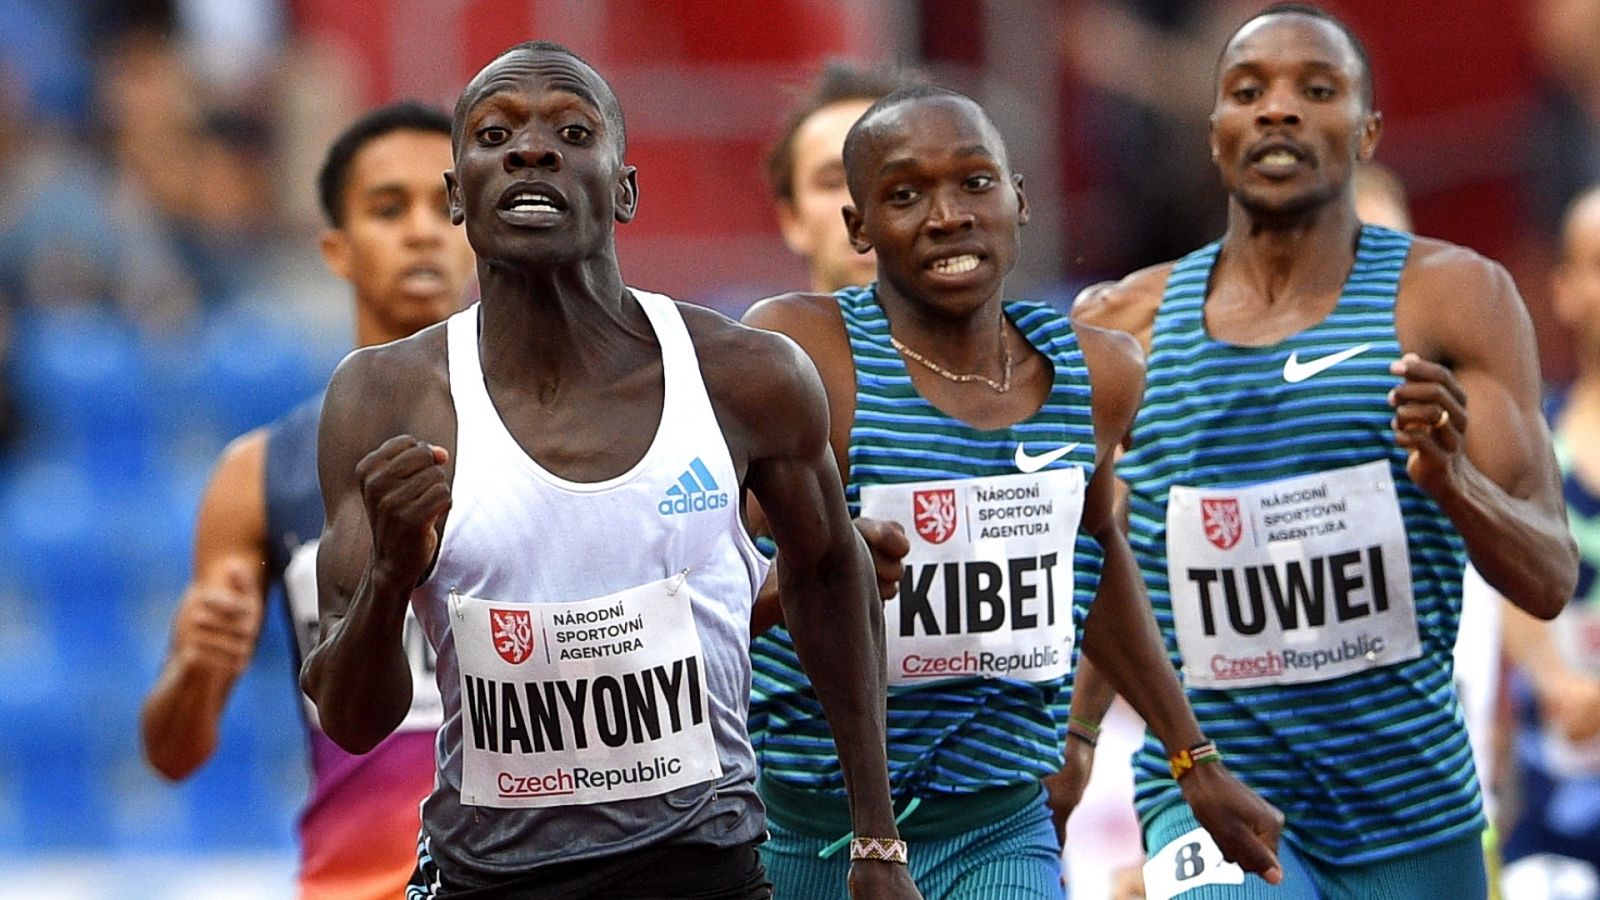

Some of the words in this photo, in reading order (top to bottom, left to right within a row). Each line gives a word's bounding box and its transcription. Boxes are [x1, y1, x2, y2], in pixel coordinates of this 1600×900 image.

[658, 491, 728, 515] adidas
[977, 482, 1040, 503] NÁRODNÍ
[1260, 483, 1328, 509] NÁRODNÍ
[978, 500, 1053, 521] SPORTOVNÍ
[1264, 499, 1347, 527] SPORTOVNÍ
[980, 523, 1050, 540] AGENTURA
[1268, 521, 1346, 542] AGENTURA
[899, 552, 1058, 637] KIBET
[1187, 545, 1390, 637] TUWEI
[553, 600, 625, 626] NÁRODNÍ
[556, 614, 644, 643] SPORTOVNÍ
[560, 638, 644, 661] AGENTURA
[465, 656, 704, 754] WANYONYI
[1175, 842, 1205, 881] 8
